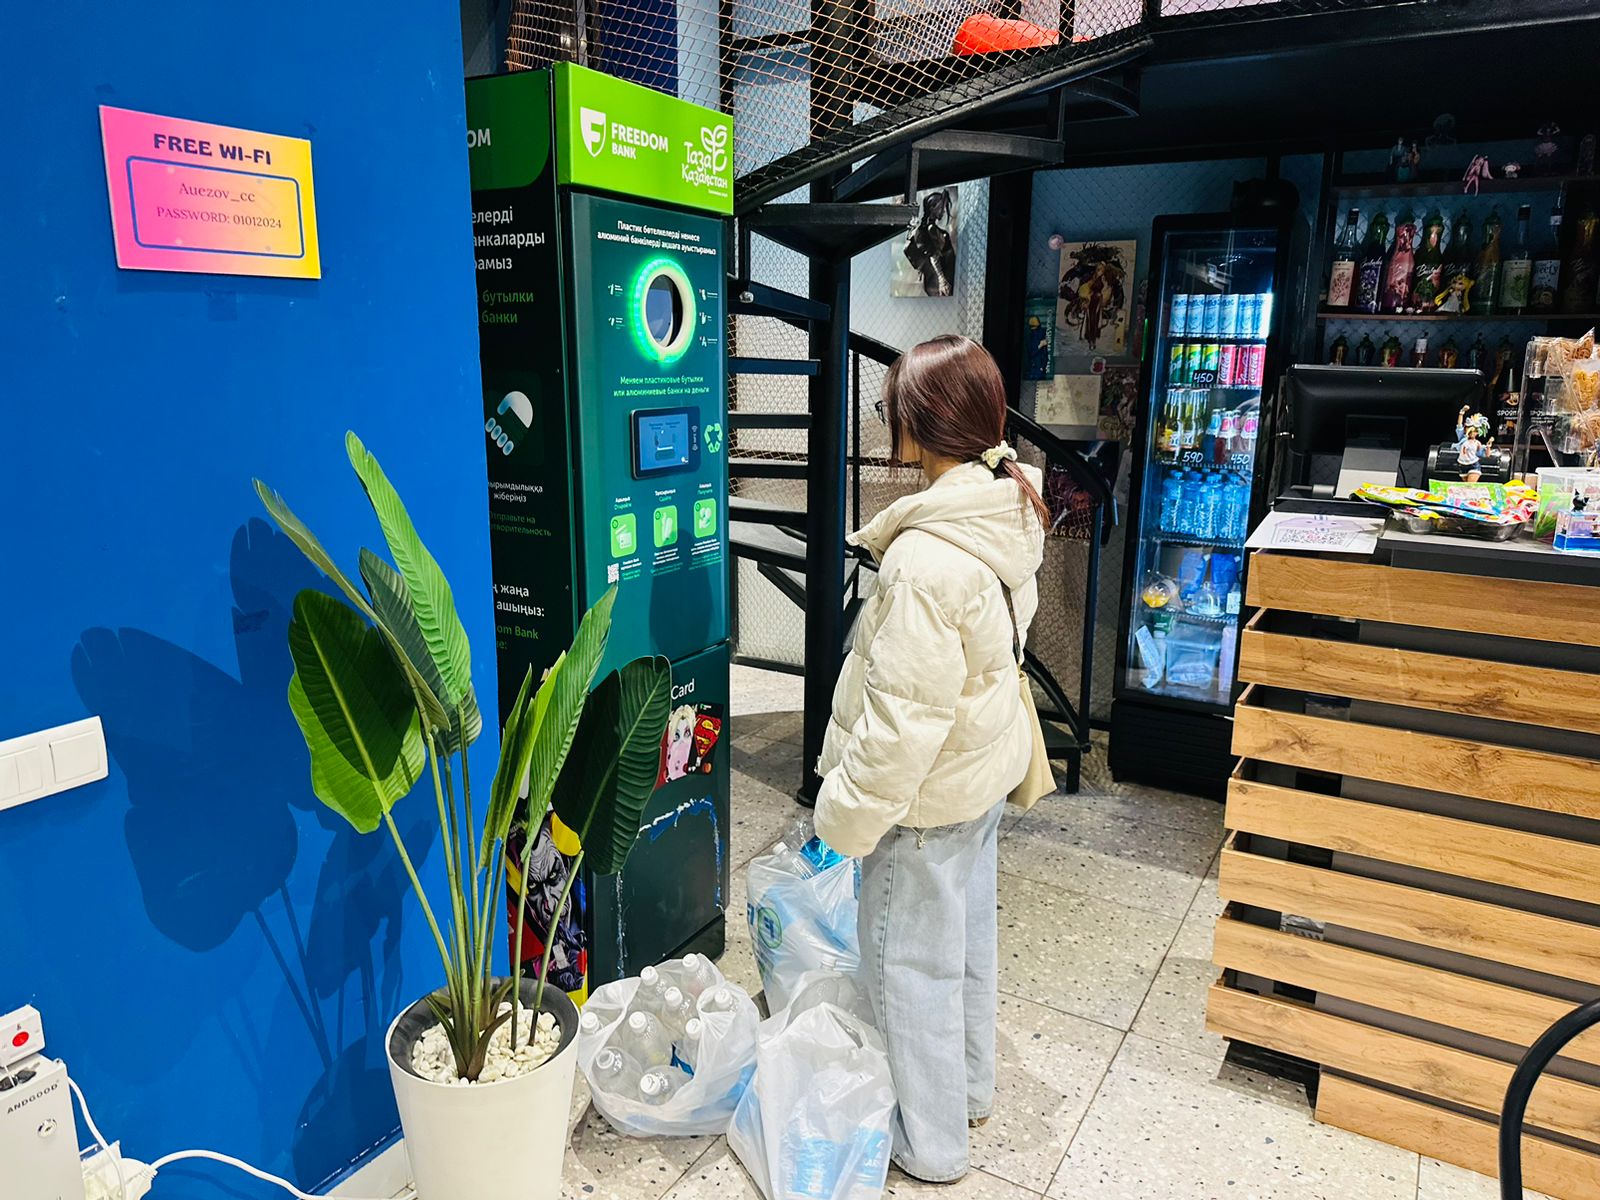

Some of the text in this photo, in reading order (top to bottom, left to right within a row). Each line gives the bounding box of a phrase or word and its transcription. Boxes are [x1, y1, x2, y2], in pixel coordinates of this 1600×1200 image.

[611, 122, 669, 152] FREEDOM
[153, 133, 271, 165] FREE WI-FI
[611, 144, 637, 160] BANK
[178, 183, 255, 203] Auezov_cc
[157, 206, 282, 229] PASSWORD: 01012024
[482, 289, 534, 306] бутылки
[481, 310, 518, 323] банки
[1193, 372, 1214, 384] 450
[1182, 451, 1204, 463] 590
[1230, 453, 1250, 465] 450
[488, 481, 543, 493] ырымдылыққа
[500, 584, 530, 598] жаңа
[496, 601, 545, 617] ашыңыз:
[515, 626, 540, 639] Bank
[671, 678, 695, 700] Card
[7, 1083, 59, 1114] ANDGOOD
